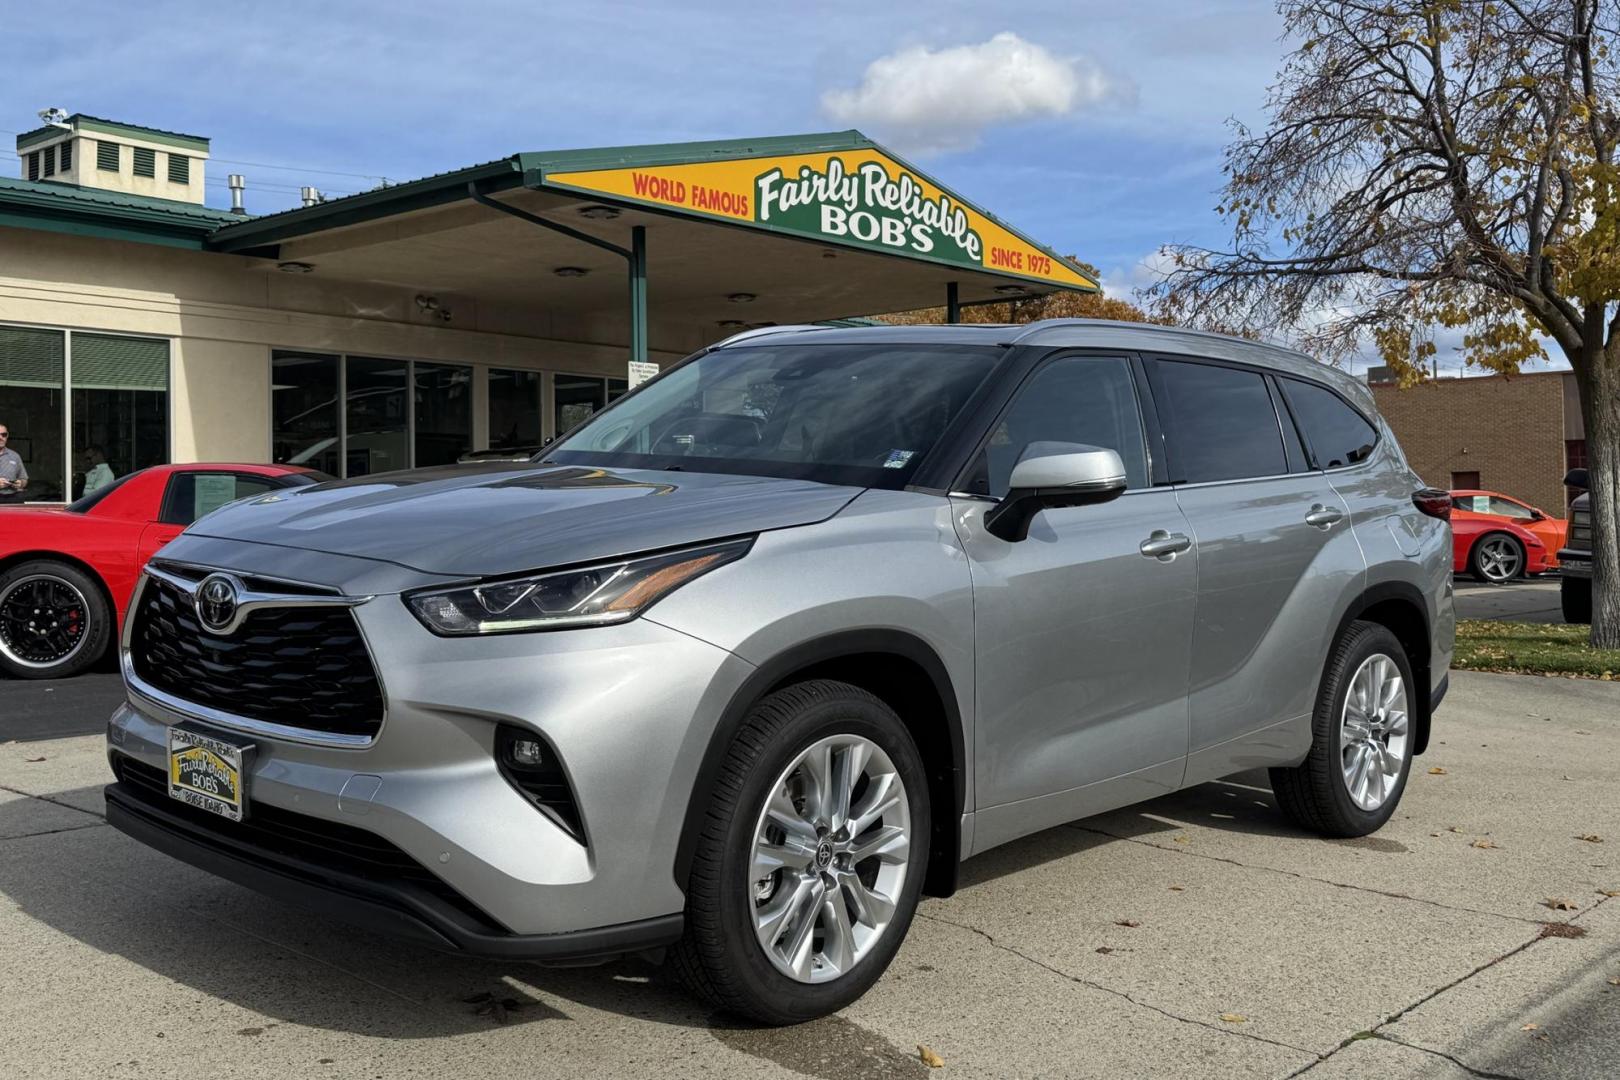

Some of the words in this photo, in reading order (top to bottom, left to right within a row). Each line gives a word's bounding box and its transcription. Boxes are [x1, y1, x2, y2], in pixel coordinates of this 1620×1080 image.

[632, 172, 686, 204] WORLD
[691, 185, 748, 217] FAMOUS
[758, 160, 858, 220] Fairly
[861, 164, 981, 260] Reliable
[821, 204, 934, 252] BOB'S
[991, 246, 1022, 269] SINCE
[1027, 254, 1051, 275] 1975
[192, 772, 218, 794] BOB'S
